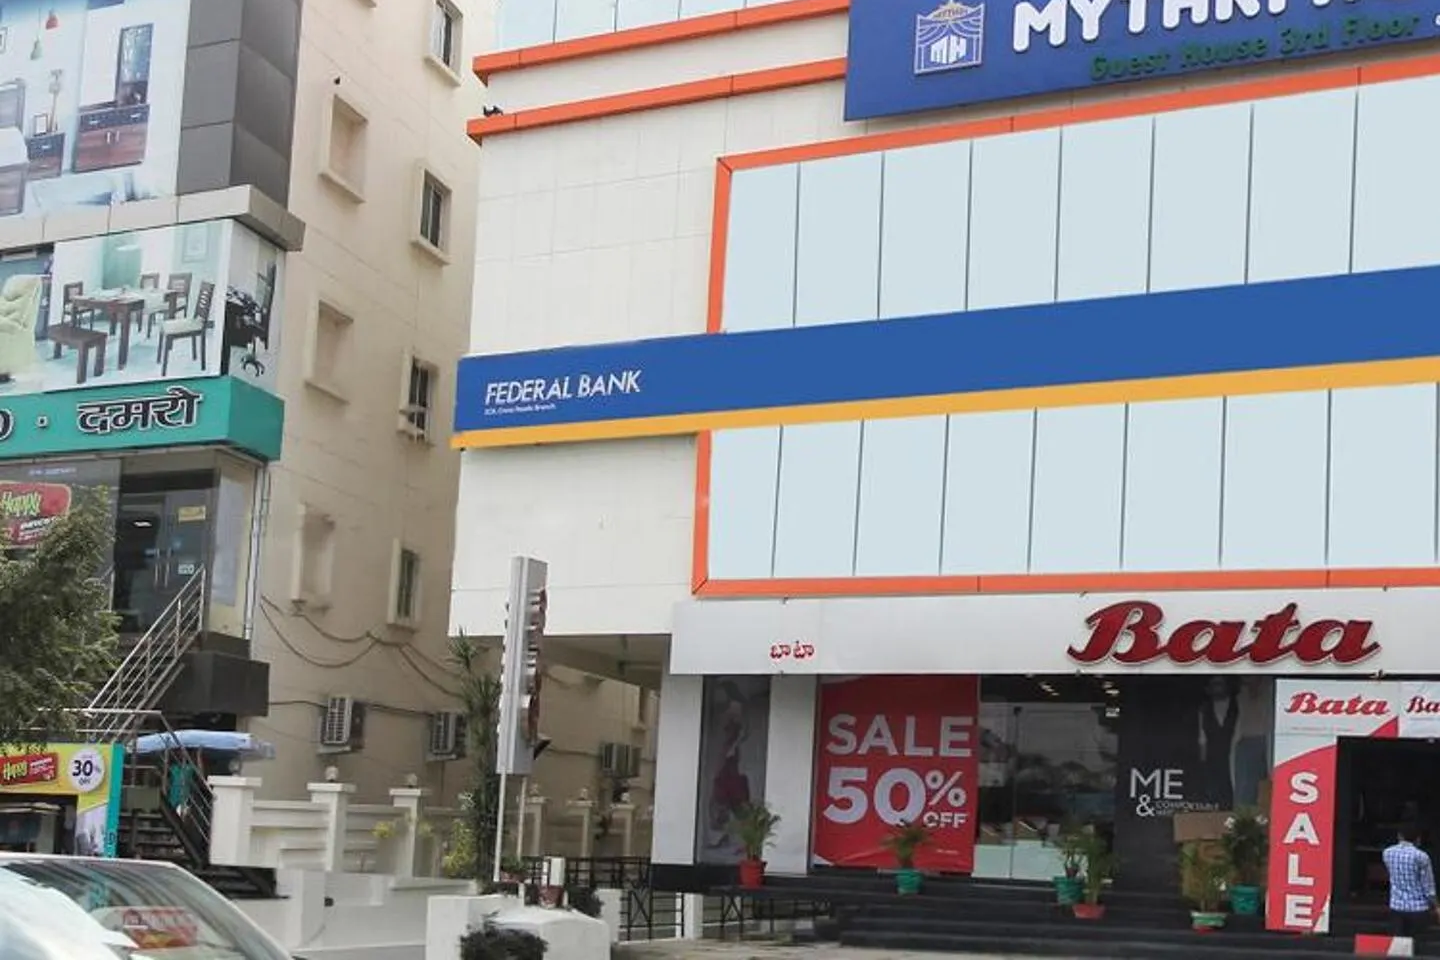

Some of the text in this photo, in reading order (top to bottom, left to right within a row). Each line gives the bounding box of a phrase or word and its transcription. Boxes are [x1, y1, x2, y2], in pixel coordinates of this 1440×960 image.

[1180, 37, 1270, 68] House
[1280, 24, 1330, 55] 3rd
[1341, 16, 1421, 46] Floor
[76, 385, 203, 434] दमरो
[485, 369, 642, 405] FEDERAL BANK
[1067, 600, 1382, 667] Bata
[1284, 691, 1391, 716] Bata
[826, 714, 973, 758] SALE
[823, 766, 967, 827] 50%
[1129, 767, 1184, 799] ME
[923, 812, 967, 829] OFF
[1283, 772, 1319, 928] SALE
